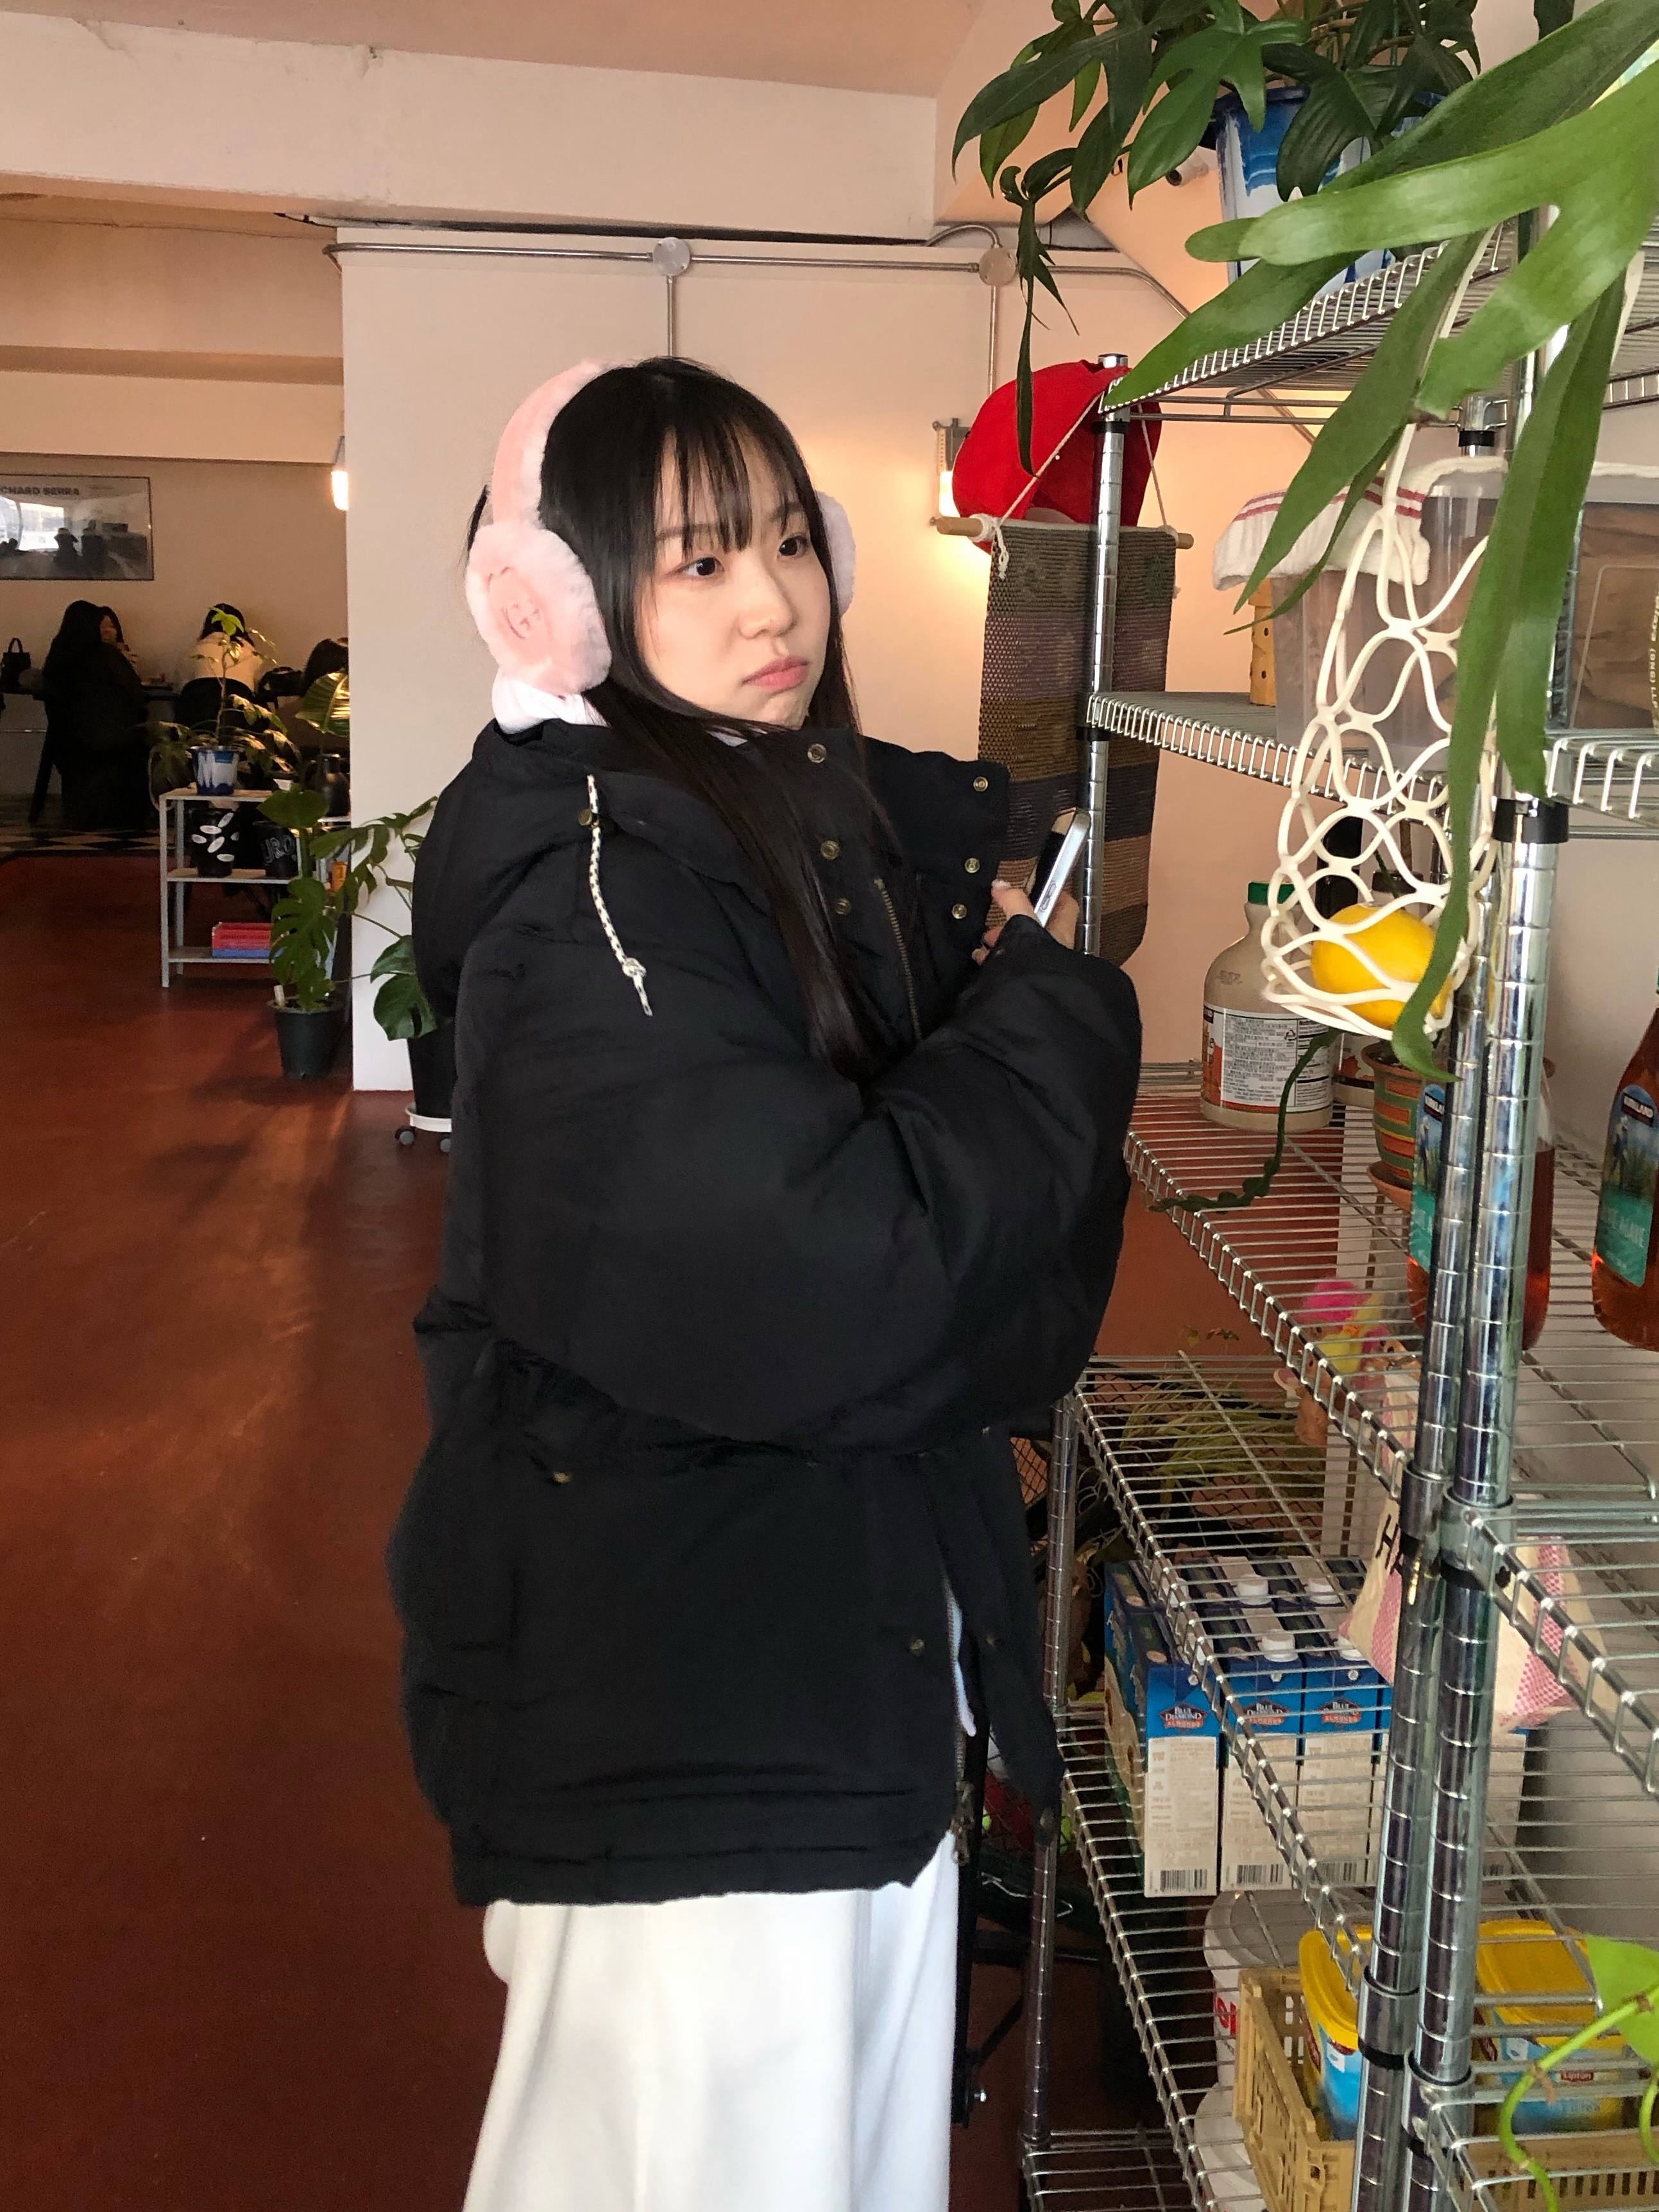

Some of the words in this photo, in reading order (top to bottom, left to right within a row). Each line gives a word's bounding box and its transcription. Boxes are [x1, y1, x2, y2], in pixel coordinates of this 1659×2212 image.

[1174, 1706, 1191, 1714] BLUE
[1255, 1703, 1273, 1711] BLUE
[1332, 1701, 1348, 1710] BLUE
[1165, 1712, 1202, 1721] DIAMOND
[1563, 2072, 1591, 2081] Lipton
